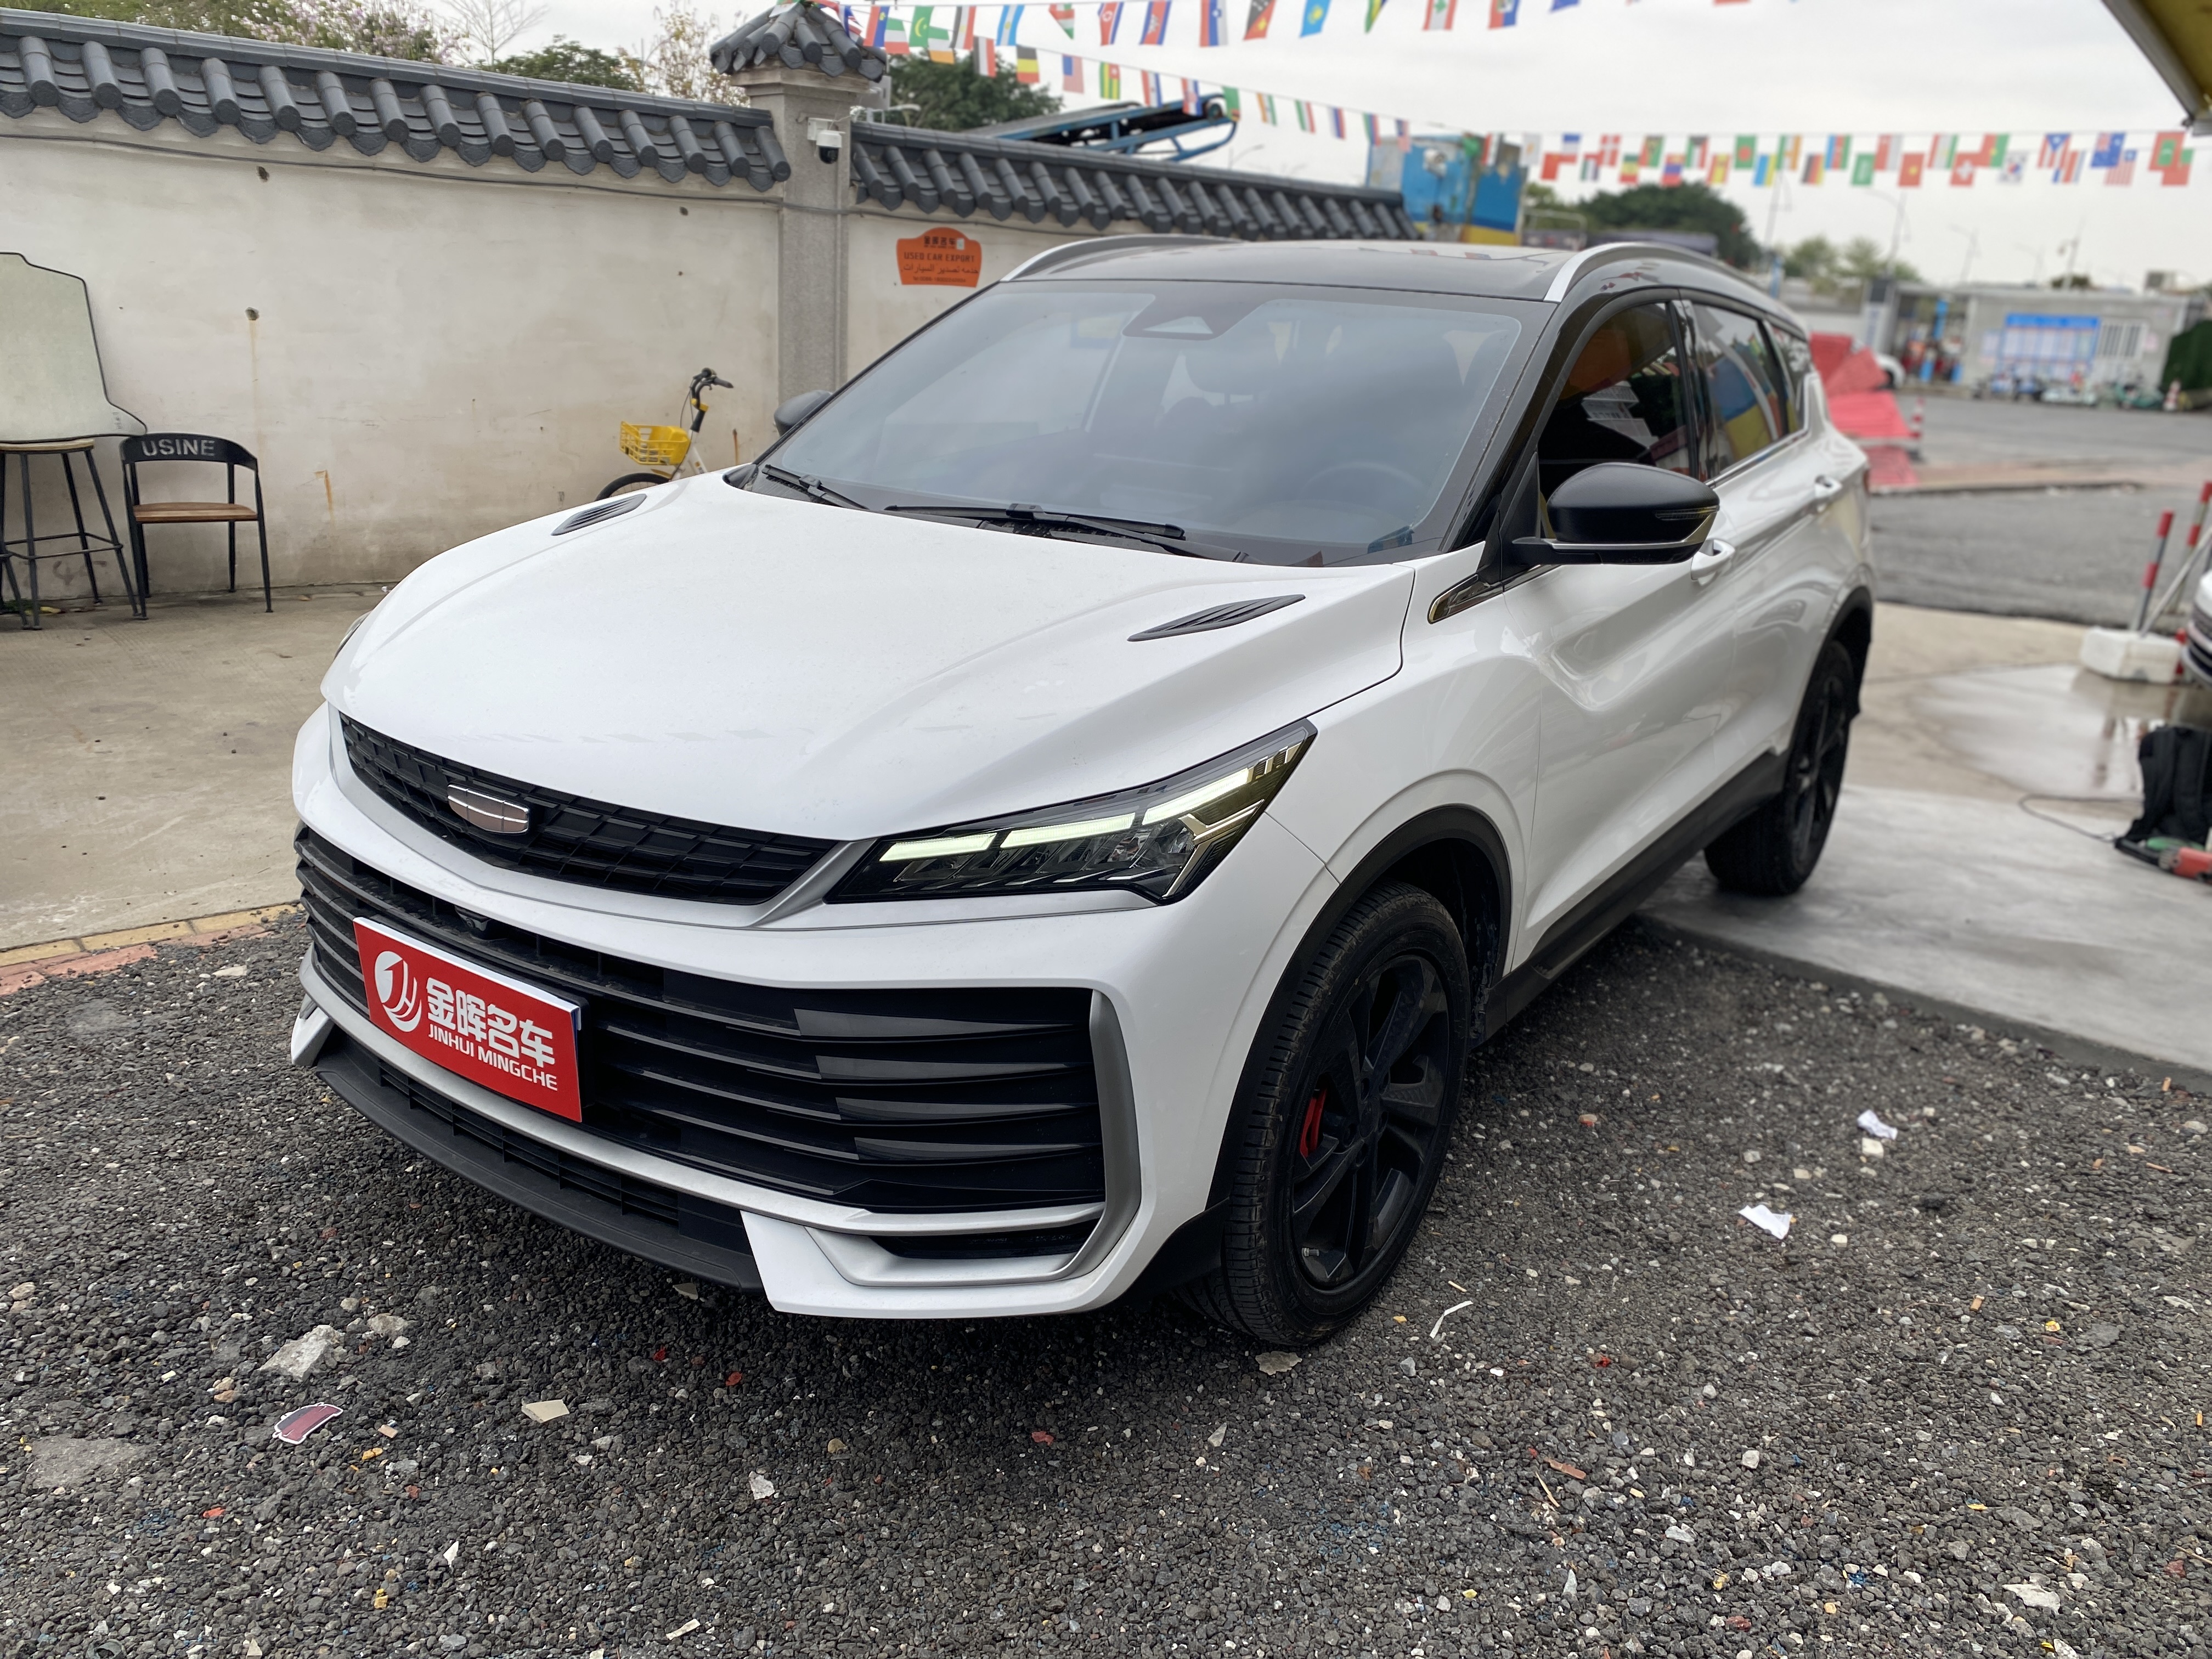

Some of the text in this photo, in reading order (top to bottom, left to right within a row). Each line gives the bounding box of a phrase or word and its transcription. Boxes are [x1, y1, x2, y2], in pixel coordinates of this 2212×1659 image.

[945, 254, 975, 262] EXPORT
[141, 439, 215, 456] USINE
[426, 977, 555, 1068] 金晖名车
[428, 1024, 558, 1091] JINHUI MINGCHE
